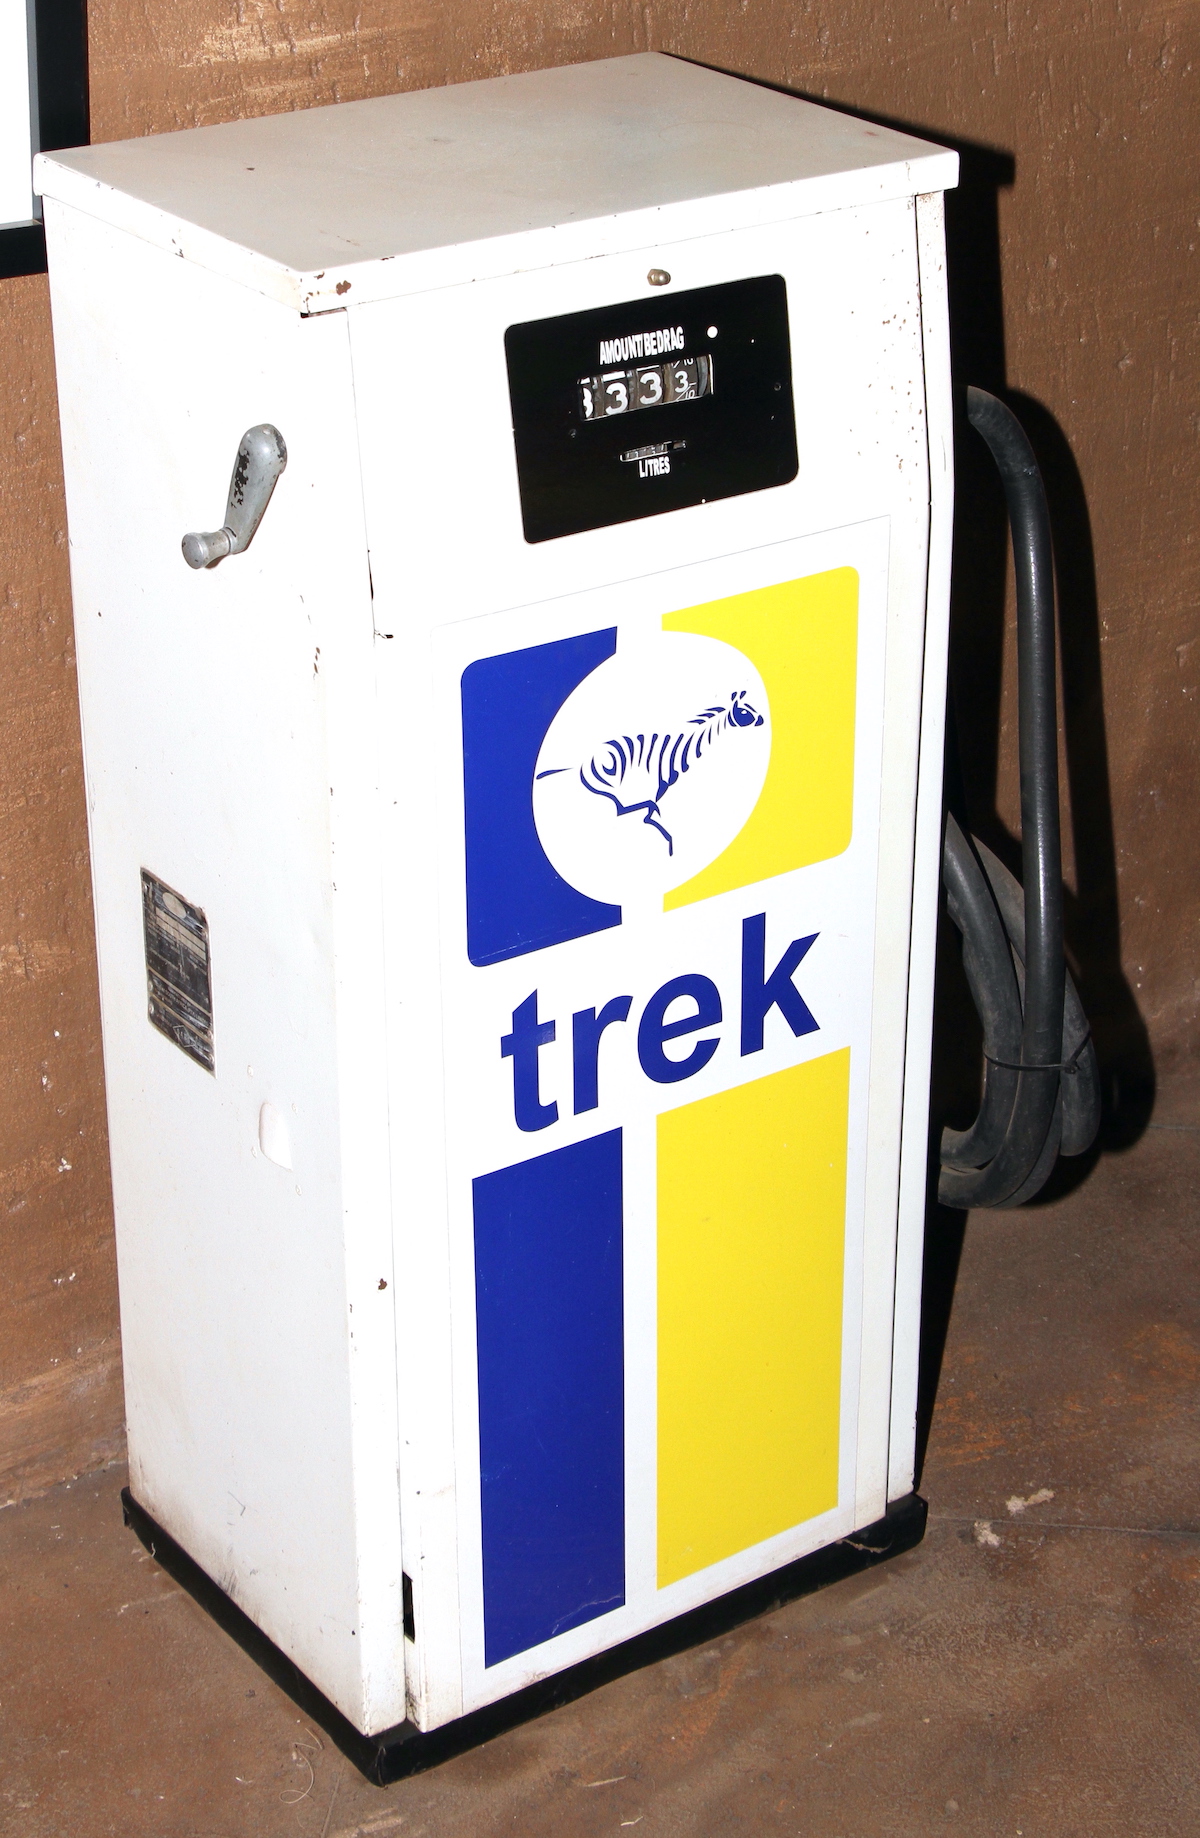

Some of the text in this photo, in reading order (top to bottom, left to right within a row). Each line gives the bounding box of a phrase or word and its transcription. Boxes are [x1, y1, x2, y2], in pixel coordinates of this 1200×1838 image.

[599, 326, 684, 365] AMOUNT/BEDRAG
[638, 455, 671, 478] LITRES
[500, 912, 821, 1132] trek
